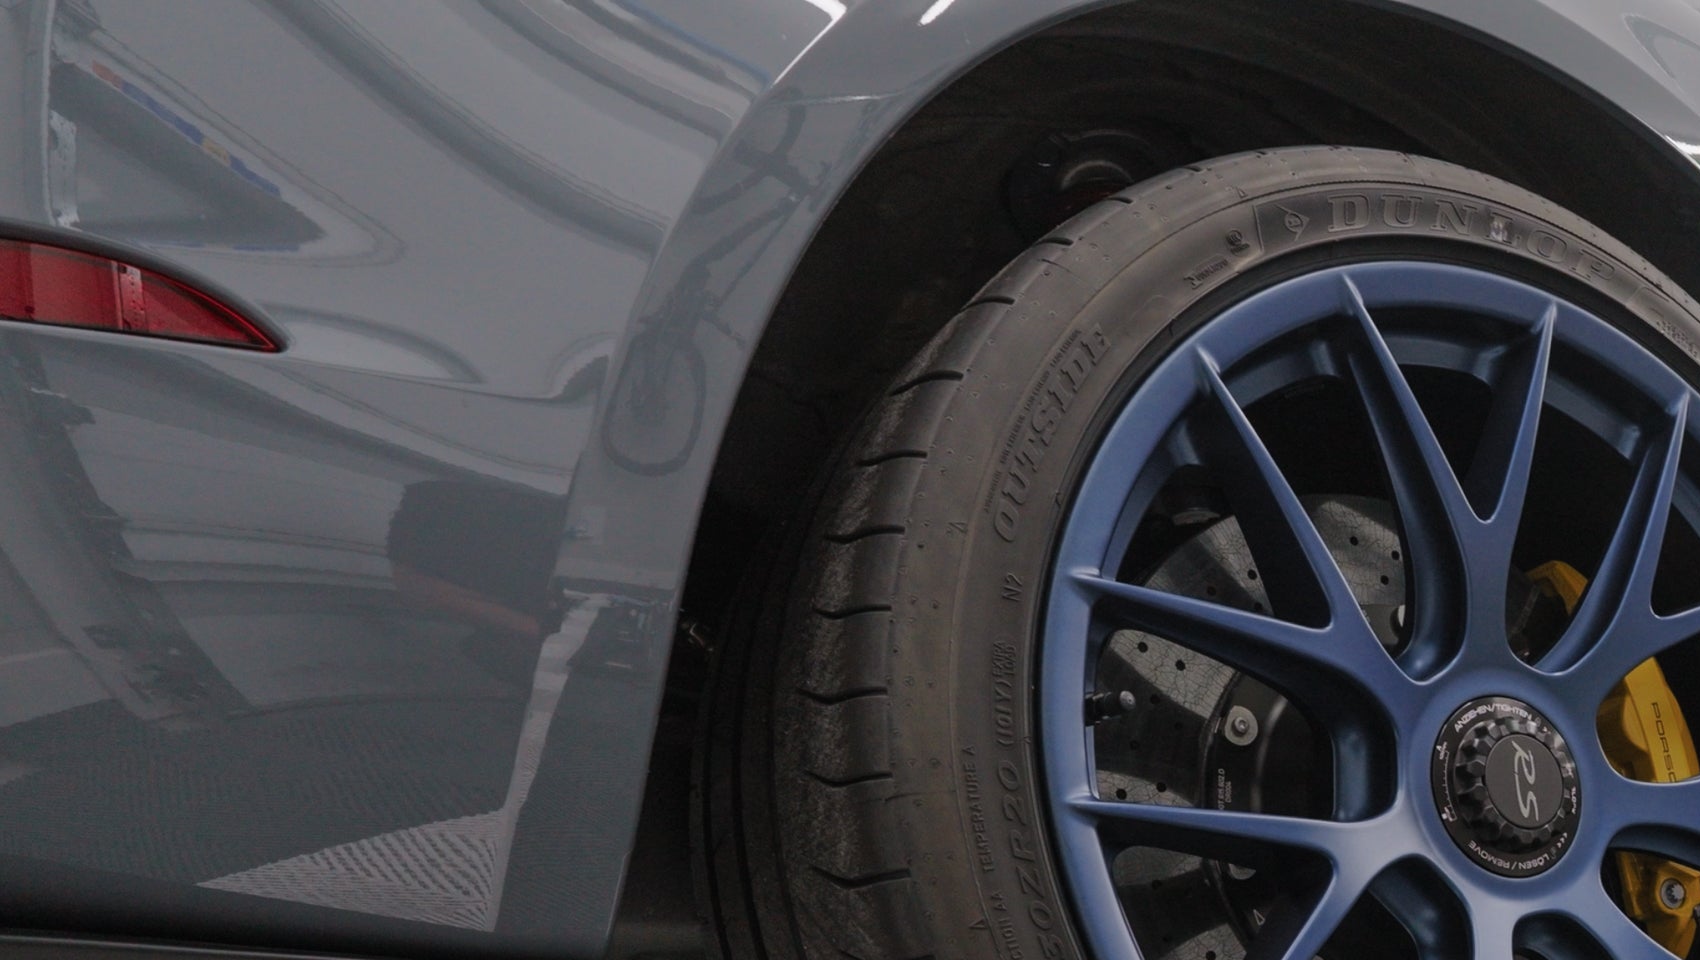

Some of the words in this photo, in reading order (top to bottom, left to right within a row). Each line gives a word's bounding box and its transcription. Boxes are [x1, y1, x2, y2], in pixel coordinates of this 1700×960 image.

[1328, 194, 1616, 282] DUNLOP
[994, 323, 1112, 543] OUTSIDE
[962, 765, 996, 873] TEMPERATURE
[1511, 739, 1540, 823] RS
